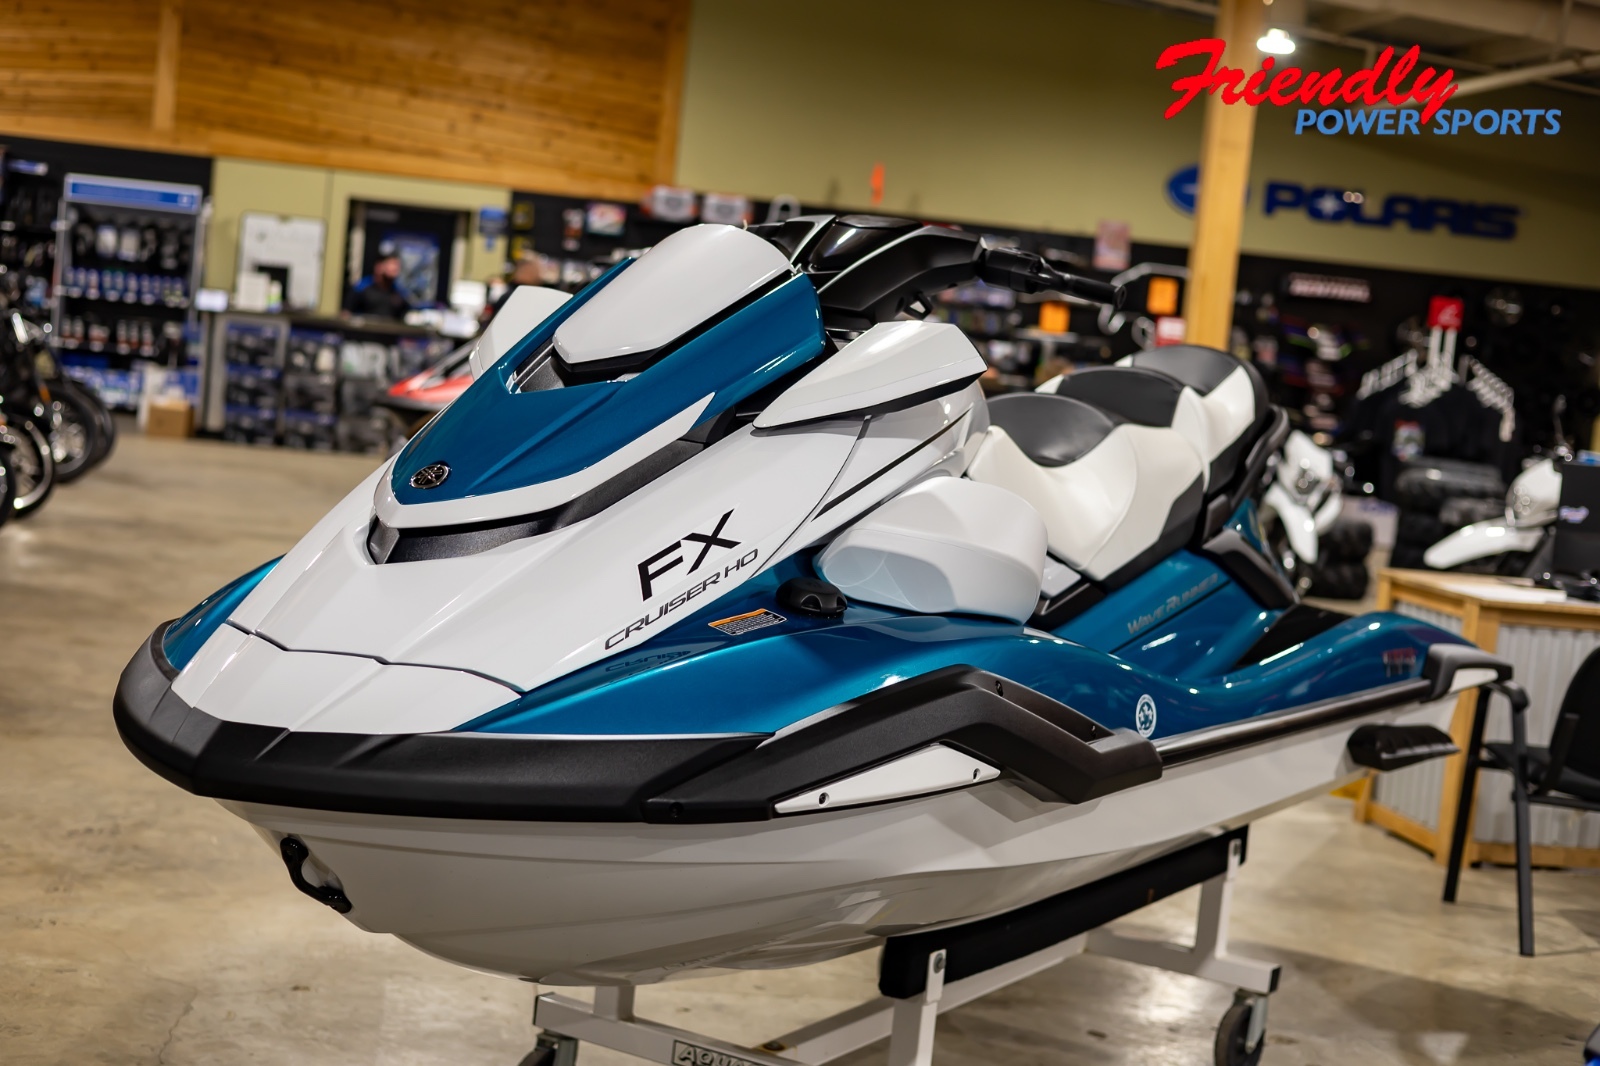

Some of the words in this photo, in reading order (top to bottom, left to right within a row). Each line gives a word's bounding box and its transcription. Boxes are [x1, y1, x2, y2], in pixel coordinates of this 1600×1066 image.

[1264, 181, 1521, 240] POLARIS
[604, 571, 720, 651] CRUISER
[724, 548, 758, 578] HO
[637, 508, 741, 602] FX
